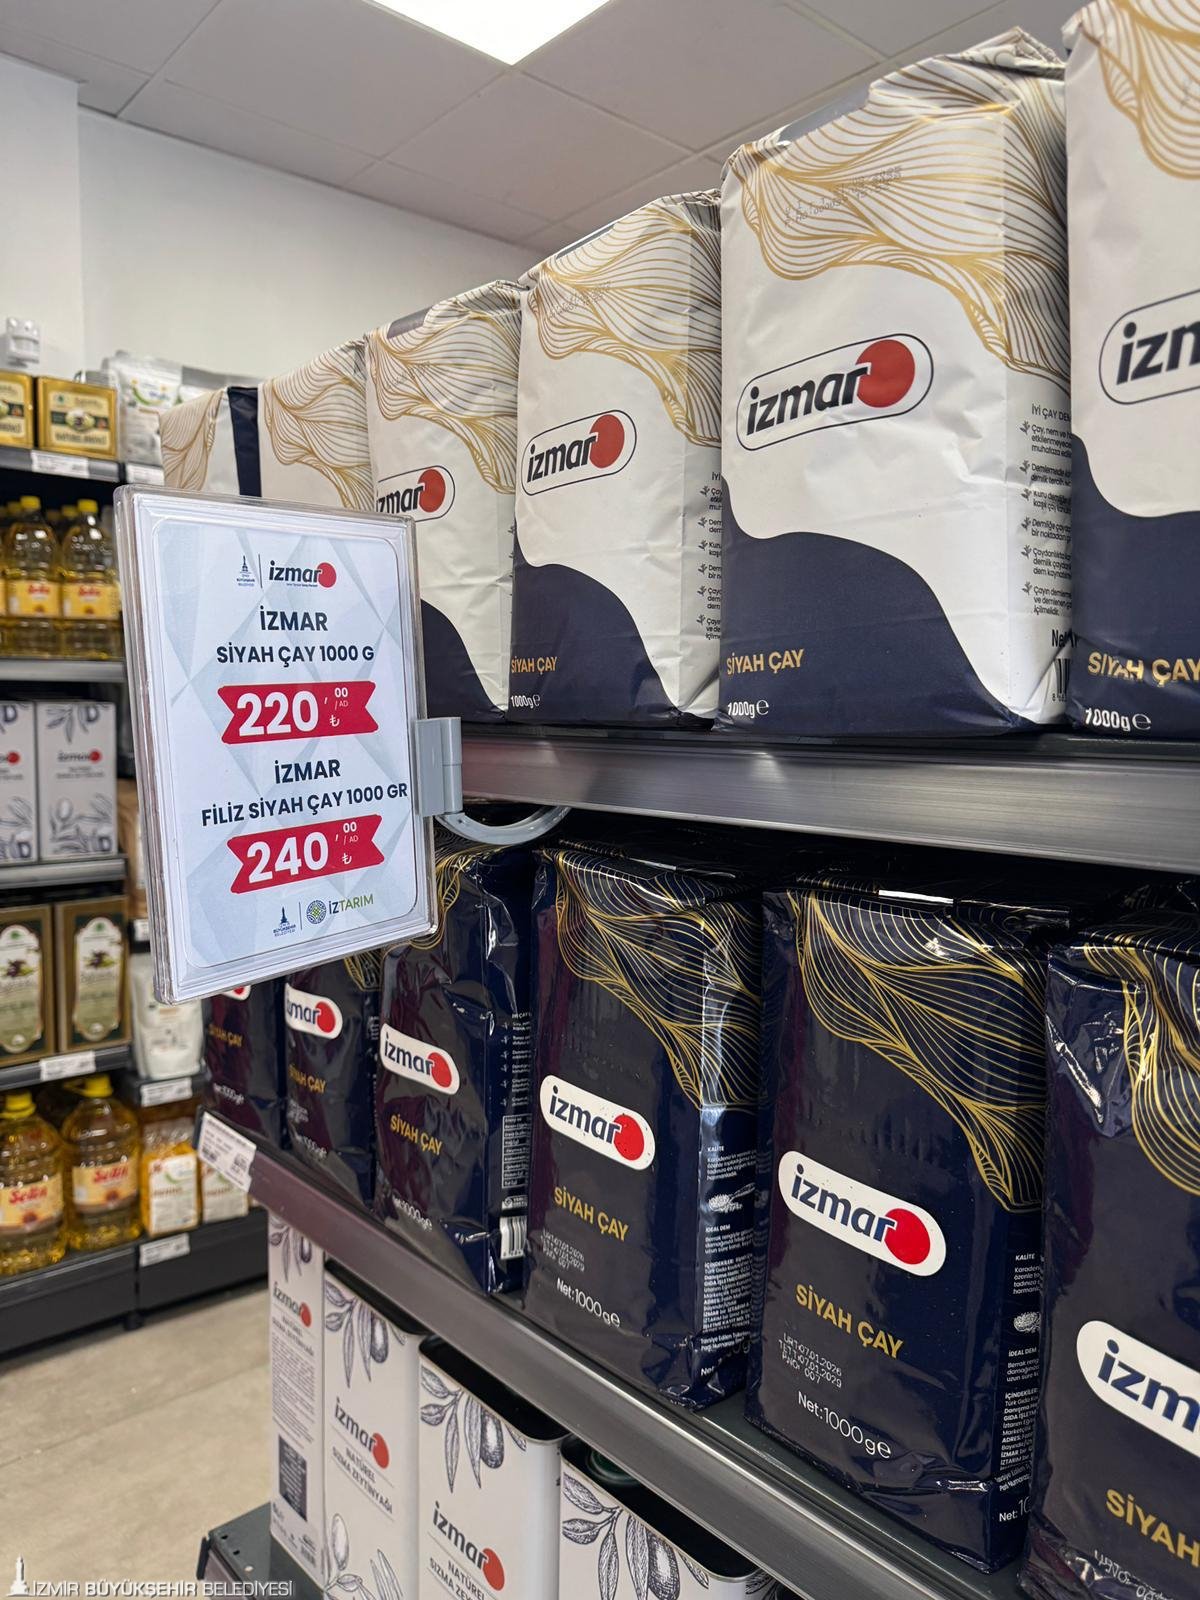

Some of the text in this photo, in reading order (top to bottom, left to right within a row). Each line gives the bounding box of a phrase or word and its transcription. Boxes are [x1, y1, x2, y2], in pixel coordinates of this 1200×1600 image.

[747, 366, 868, 435] izmar
[527, 436, 597, 483] izmar
[269, 560, 321, 583] izmar
[260, 606, 328, 631] İZMAR
[216, 643, 375, 668] SİYAH ÇAY 1000 G
[537, 657, 558, 675] ÇAY
[727, 649, 804, 675] SİYAH ÇAY
[1152, 658, 1200, 688] ÇAY
[274, 759, 341, 784] İZMAR
[201, 782, 408, 827] FİLİZ SİYAH ÇAY 1000 GR
[328, 894, 374, 915] İZTARIM
[384, 1031, 434, 1077] izmar
[390, 1114, 443, 1156] SİYAH ÇAY
[549, 1085, 621, 1145] izmar
[554, 1186, 629, 1242] SİYAH ÇAY
[791, 1163, 896, 1243] izmar
[796, 1283, 852, 1334] SİYAH
[857, 1321, 904, 1359] ÇAY
[335, 1396, 377, 1452] izmar
[433, 1500, 488, 1570] izmar
[1106, 1488, 1200, 1568] SİYAH
